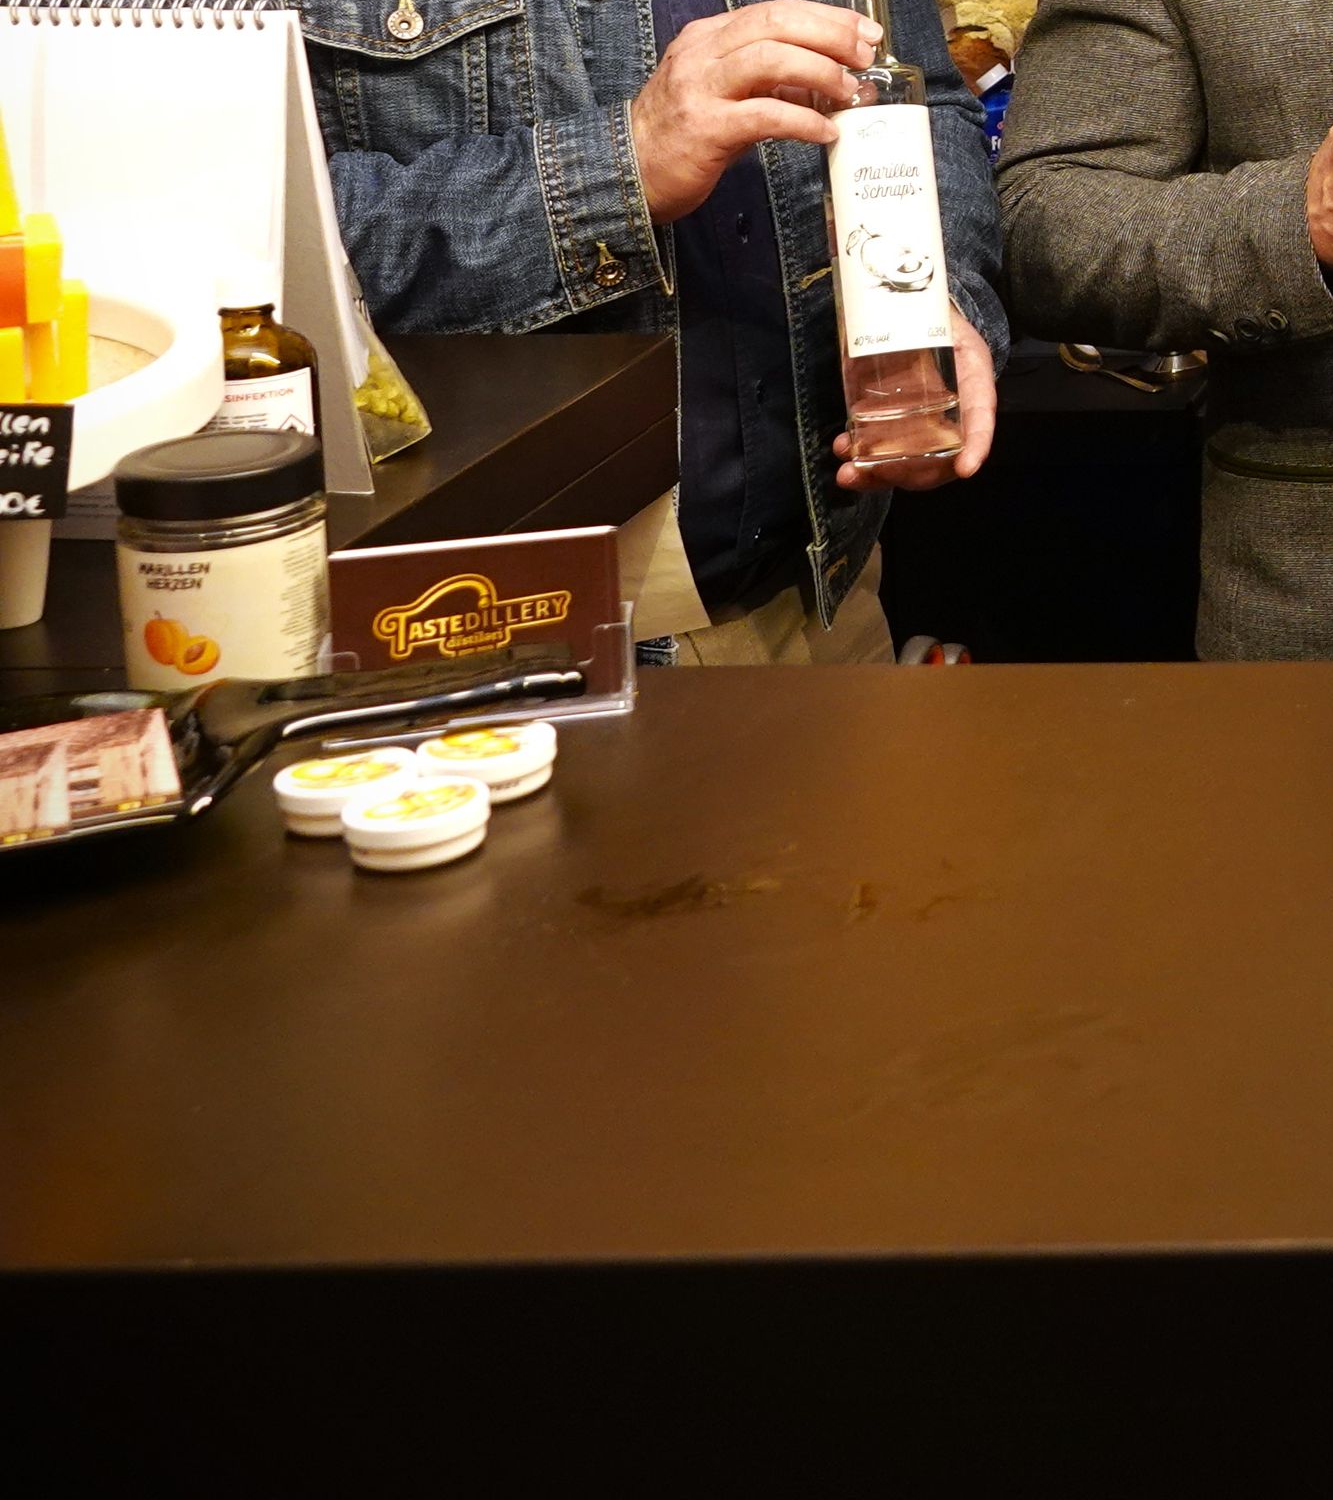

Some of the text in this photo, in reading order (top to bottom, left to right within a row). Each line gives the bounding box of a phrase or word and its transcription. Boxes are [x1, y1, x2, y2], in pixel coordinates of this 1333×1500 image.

[138, 561, 211, 577] MARILLEN
[146, 576, 205, 592] HERZEN
[378, 579, 567, 653] TASTEDILLERY
